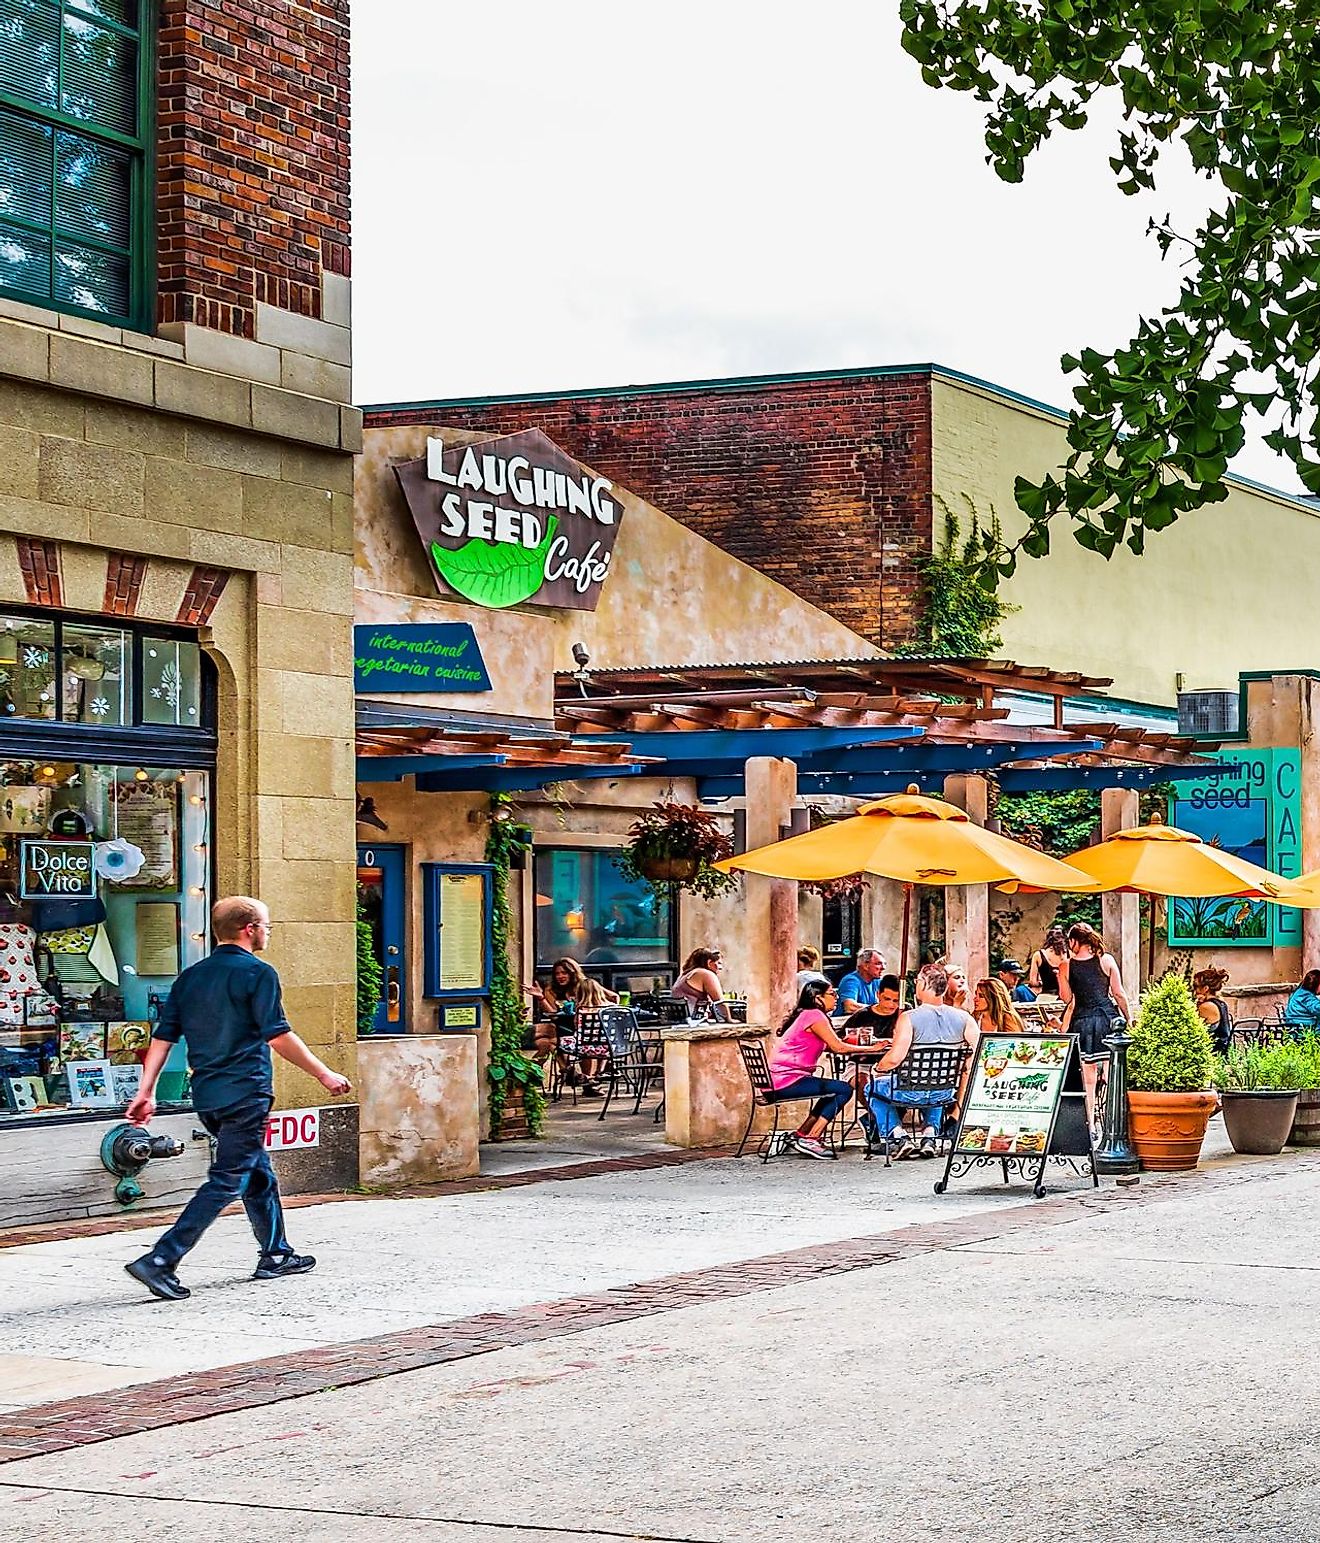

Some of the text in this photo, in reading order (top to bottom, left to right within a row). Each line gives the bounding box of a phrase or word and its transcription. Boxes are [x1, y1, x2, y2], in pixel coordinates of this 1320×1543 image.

[427, 436, 614, 525] LAUGHING
[440, 493, 541, 549] SEED
[544, 536, 611, 593] Café
[369, 632, 469, 658] international
[354, 656, 481, 681] egetarian cuisine
[1190, 783, 1250, 810] seed
[31, 846, 88, 871] Dolce
[37, 871, 82, 893] Vita
[265, 1114, 316, 1147] FDC
